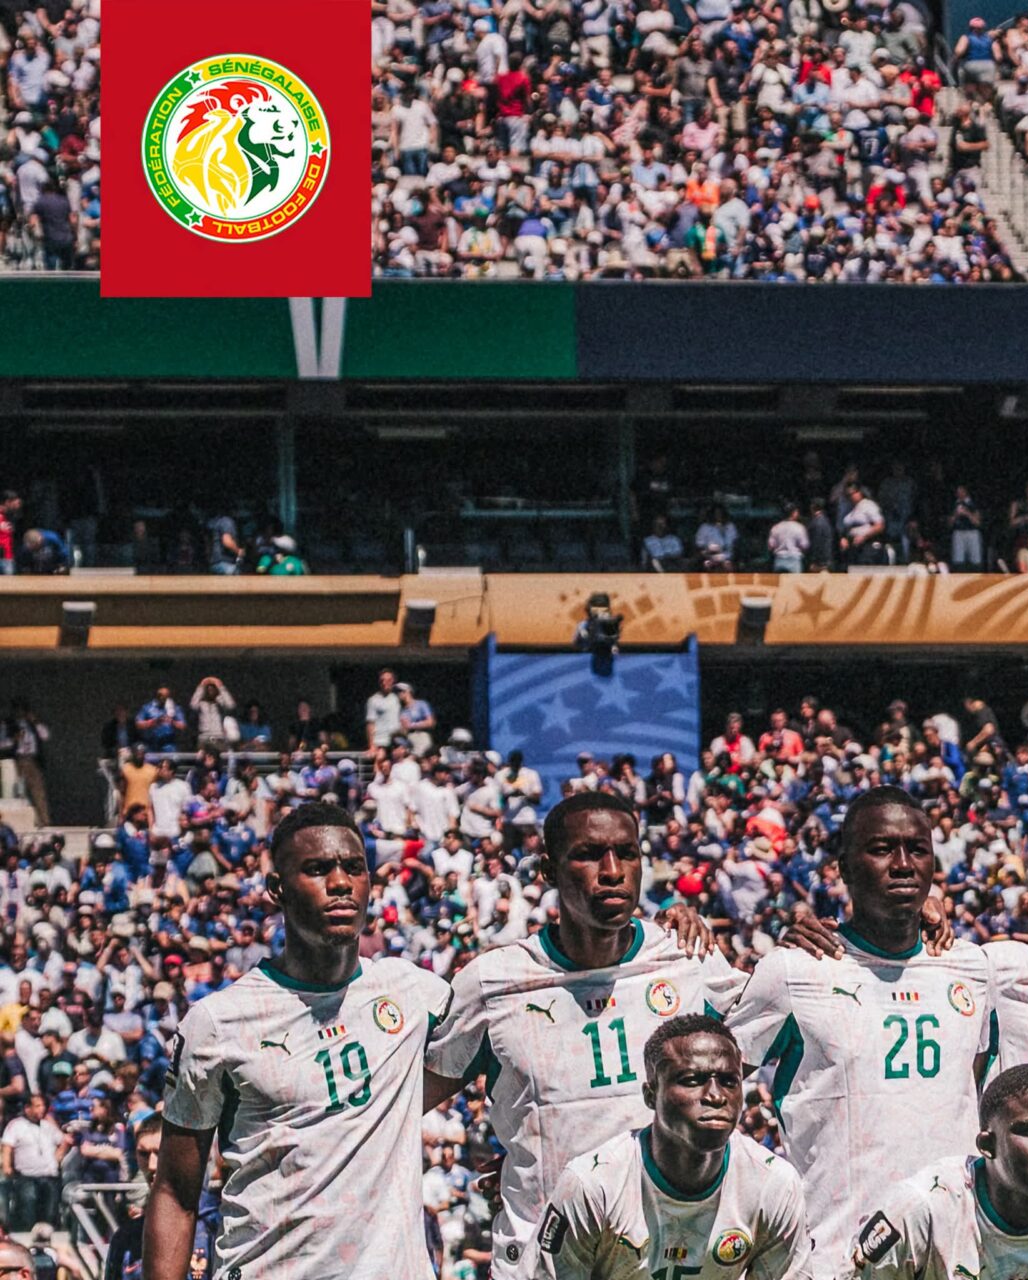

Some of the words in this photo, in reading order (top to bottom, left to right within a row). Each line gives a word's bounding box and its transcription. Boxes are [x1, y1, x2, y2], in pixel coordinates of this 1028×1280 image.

[314, 1040, 372, 1113] 19
[582, 1016, 637, 1089] 11
[883, 1014, 941, 1080] 26
